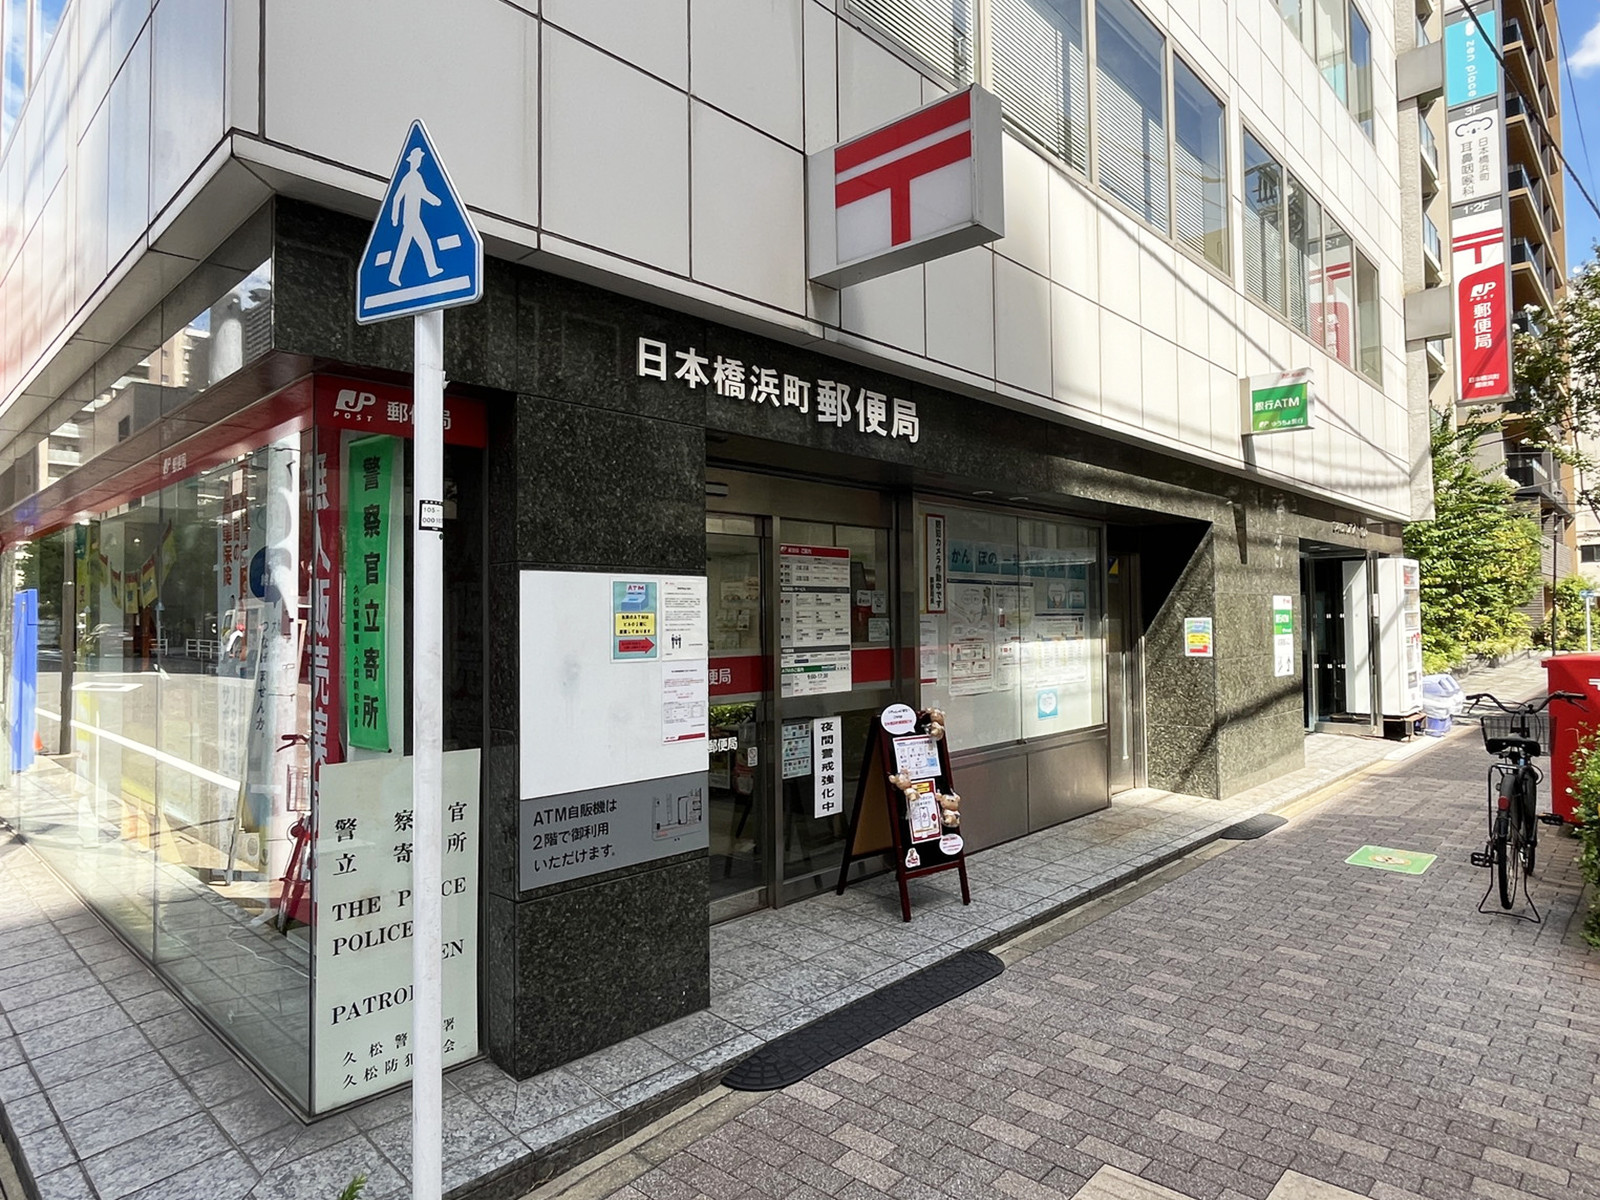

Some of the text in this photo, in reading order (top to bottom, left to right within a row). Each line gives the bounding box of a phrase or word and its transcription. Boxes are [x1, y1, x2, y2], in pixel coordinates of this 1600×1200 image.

[1465, 40, 1477, 97] zen place
[1465, 103, 1481, 116] 3F
[1461, 141, 1475, 197] 耳鼻咽喉科
[1478, 137, 1489, 181] 日本橋浜町
[1473, 302, 1493, 350] 郵便局
[636, 336, 921, 443] 日本橋浜町郵便局
[1254, 397, 1300, 411] 銀行ATM
[333, 411, 373, 422] POST
[362, 455, 382, 730] 警察官立寄所
[820, 722, 835, 812] 夜間警戒強化中
[533, 799, 618, 827] ATM自販機は
[532, 822, 609, 851] 2階で御利用
[534, 843, 616, 873] いただけます。
[332, 877, 467, 922] THE PCE
[332, 920, 414, 957] POLICE
[343, 1017, 455, 1067] 久松警署
